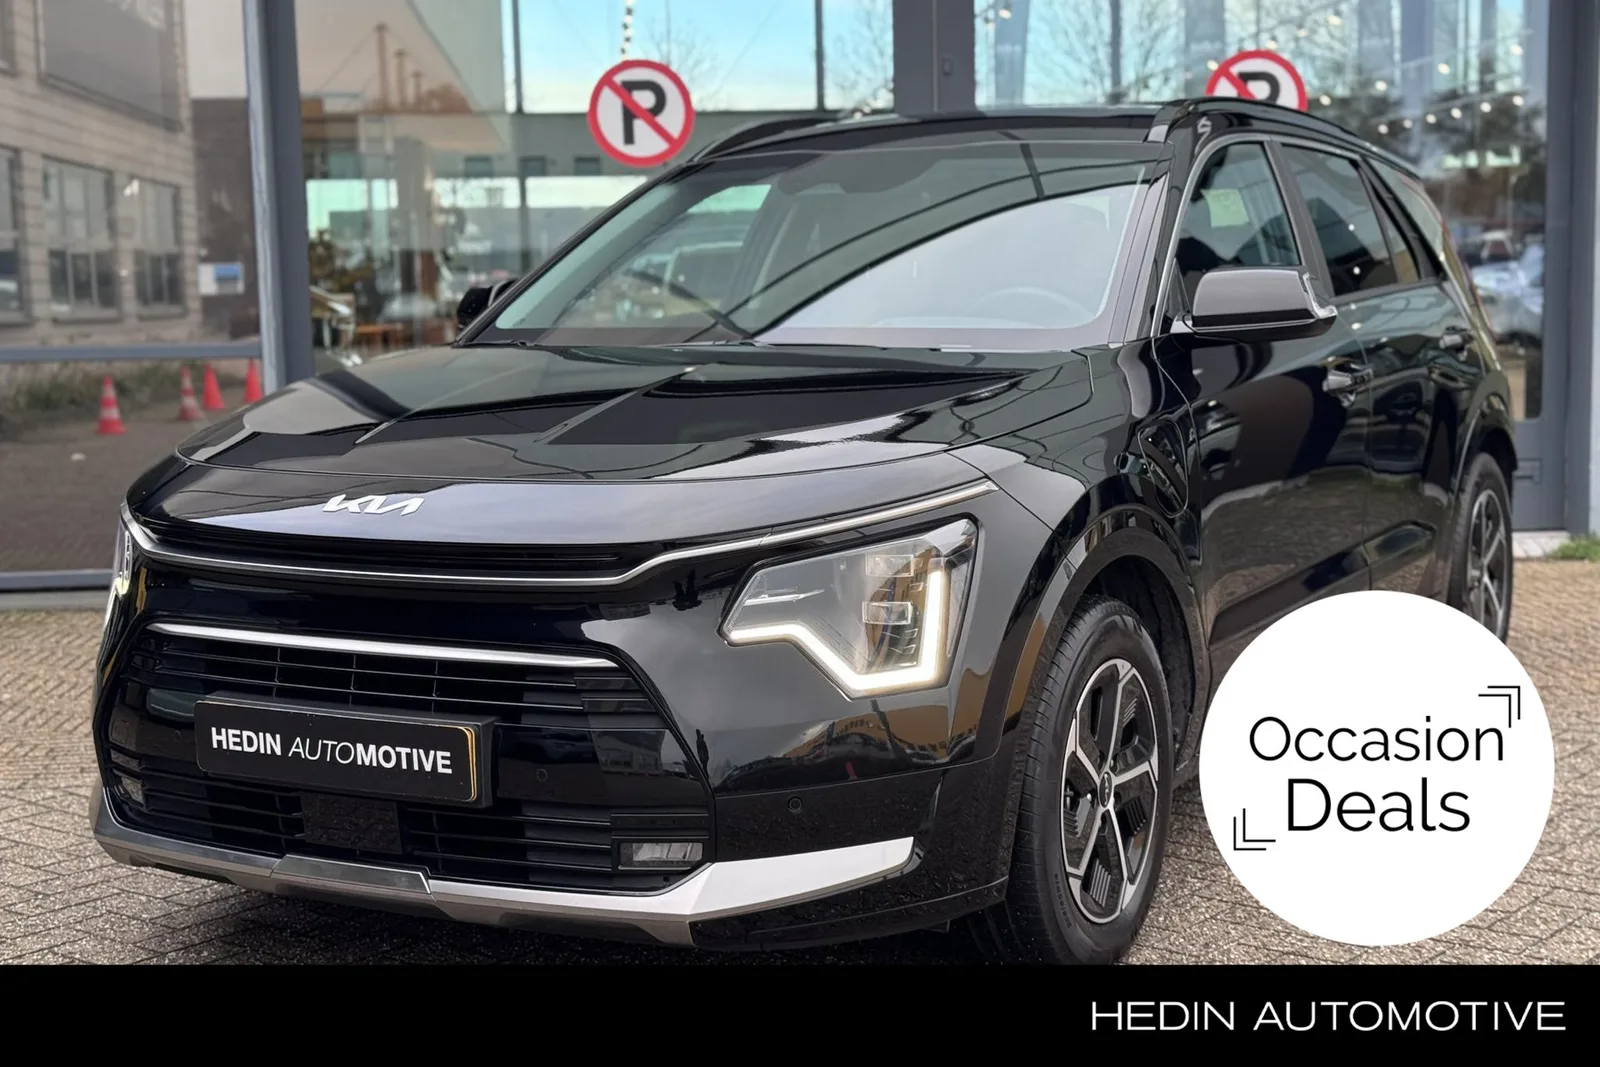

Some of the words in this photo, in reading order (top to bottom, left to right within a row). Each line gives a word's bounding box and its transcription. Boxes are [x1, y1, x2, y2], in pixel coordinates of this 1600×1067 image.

[621, 80, 666, 145] P
[322, 493, 425, 517] KIA
[211, 726, 282, 756] HEDIN
[288, 737, 453, 774] AUTOMOTIVE
